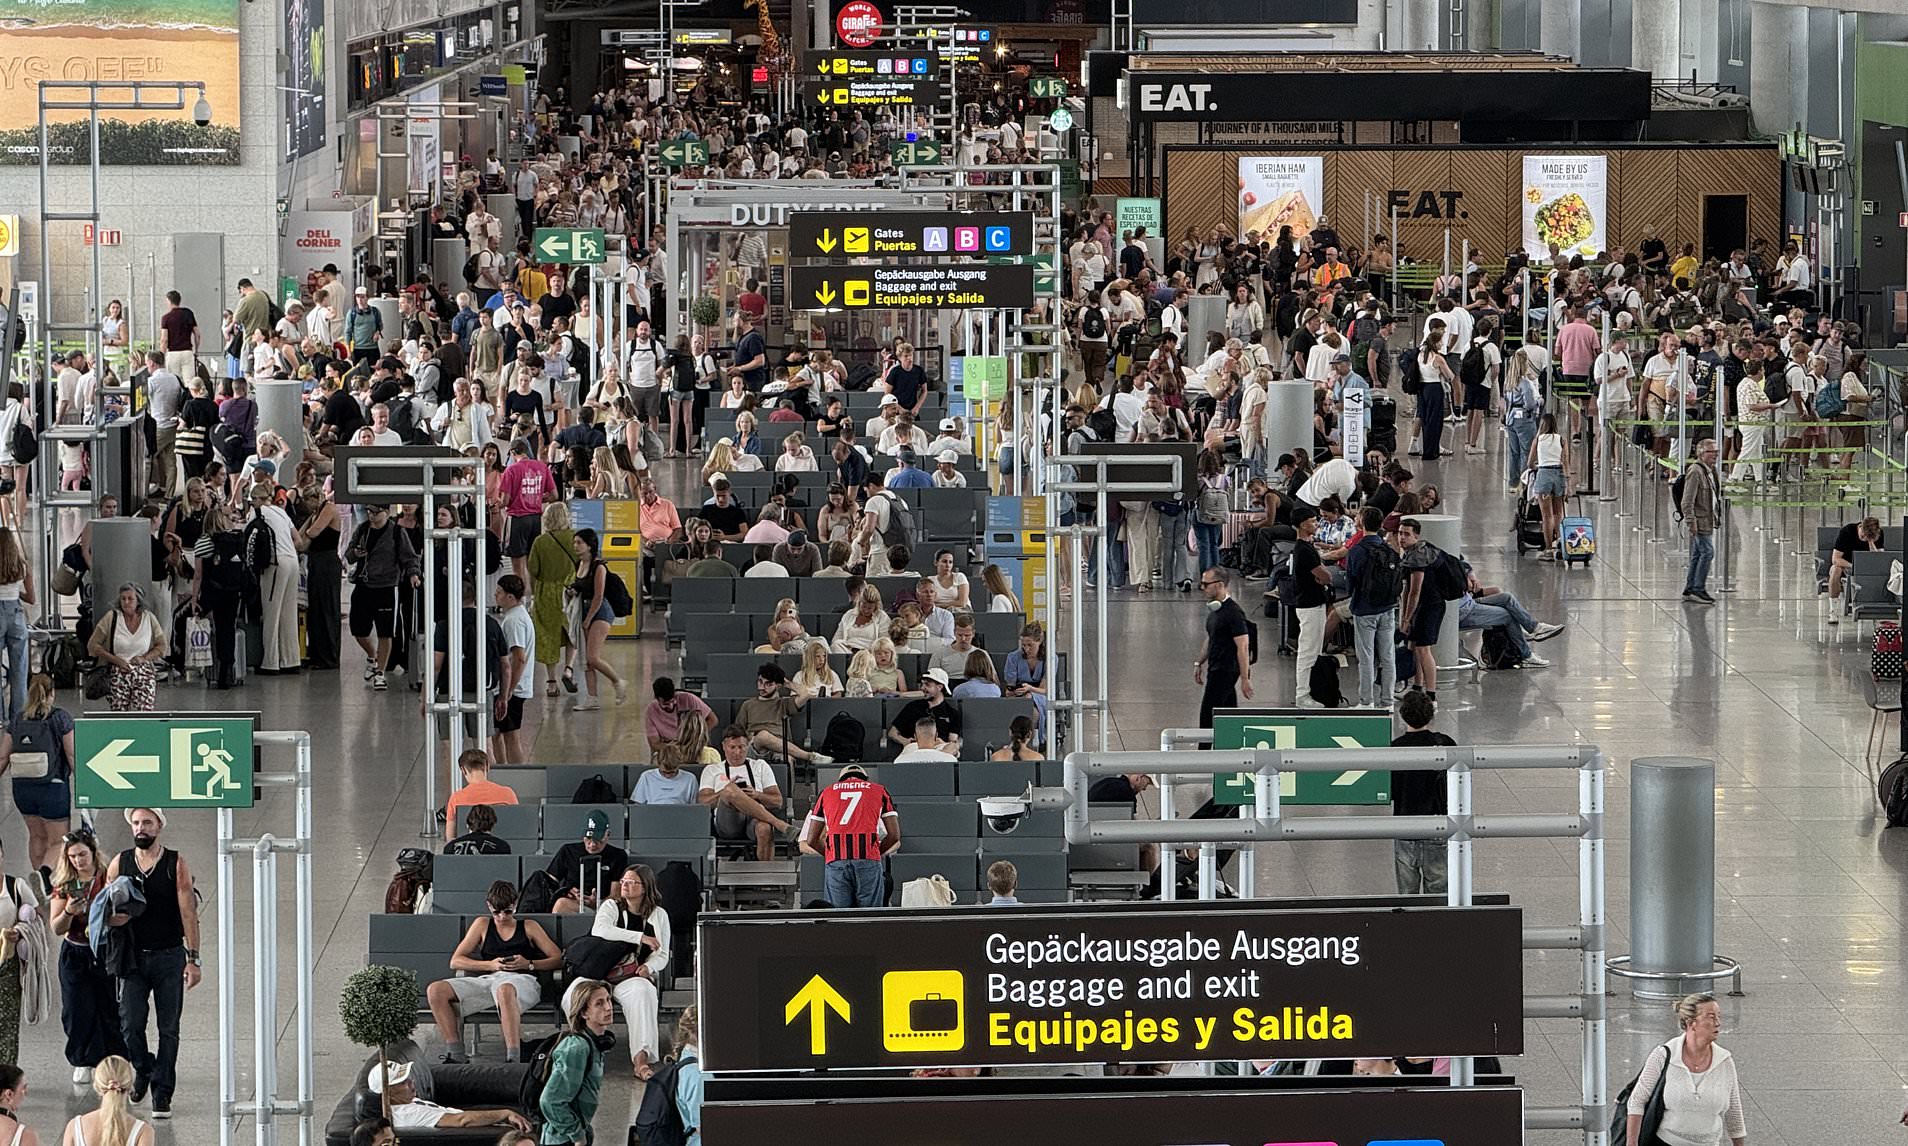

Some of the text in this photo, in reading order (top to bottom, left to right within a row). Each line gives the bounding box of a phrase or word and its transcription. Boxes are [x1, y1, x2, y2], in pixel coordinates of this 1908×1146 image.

[842, 14, 877, 30] GIRAFFE
[880, 62, 890, 72] A
[898, 62, 906, 71] B
[915, 62, 924, 71] C
[851, 96, 884, 104] Equipajes
[1140, 84, 1218, 112] EAT.
[1211, 123, 1249, 134] JOURNEY
[1251, 123, 1262, 134] OF
[1264, 123, 1270, 134] A
[1272, 123, 1316, 134] THOUSAND
[1256, 164, 1306, 174] IBERIAN HAM
[1542, 164, 1588, 174] MADE BY US
[1388, 190, 1468, 218] EAT.
[306, 230, 330, 238] DELI
[874, 229, 904, 238] Gates
[928, 230, 942, 248] A
[960, 230, 974, 248] B
[991, 230, 1004, 248] C
[296, 239, 341, 248] CORNER
[874, 241, 916, 251] Puertas
[874, 270, 986, 282] Gepäckausgabe Ausgang
[876, 282, 957, 293] Baggage and exit
[876, 293, 984, 306] Equipajes y Salida
[522, 476, 542, 486] staff
[522, 486, 542, 494] staff
[832, 782, 872, 790] GIMENEZ
[840, 791, 862, 826] 7
[985, 930, 1360, 968] Gepäckausgabe Ausgang
[988, 968, 1260, 1008] Baggage and exit
[988, 1006, 1354, 1052] Equipajes y Salida
